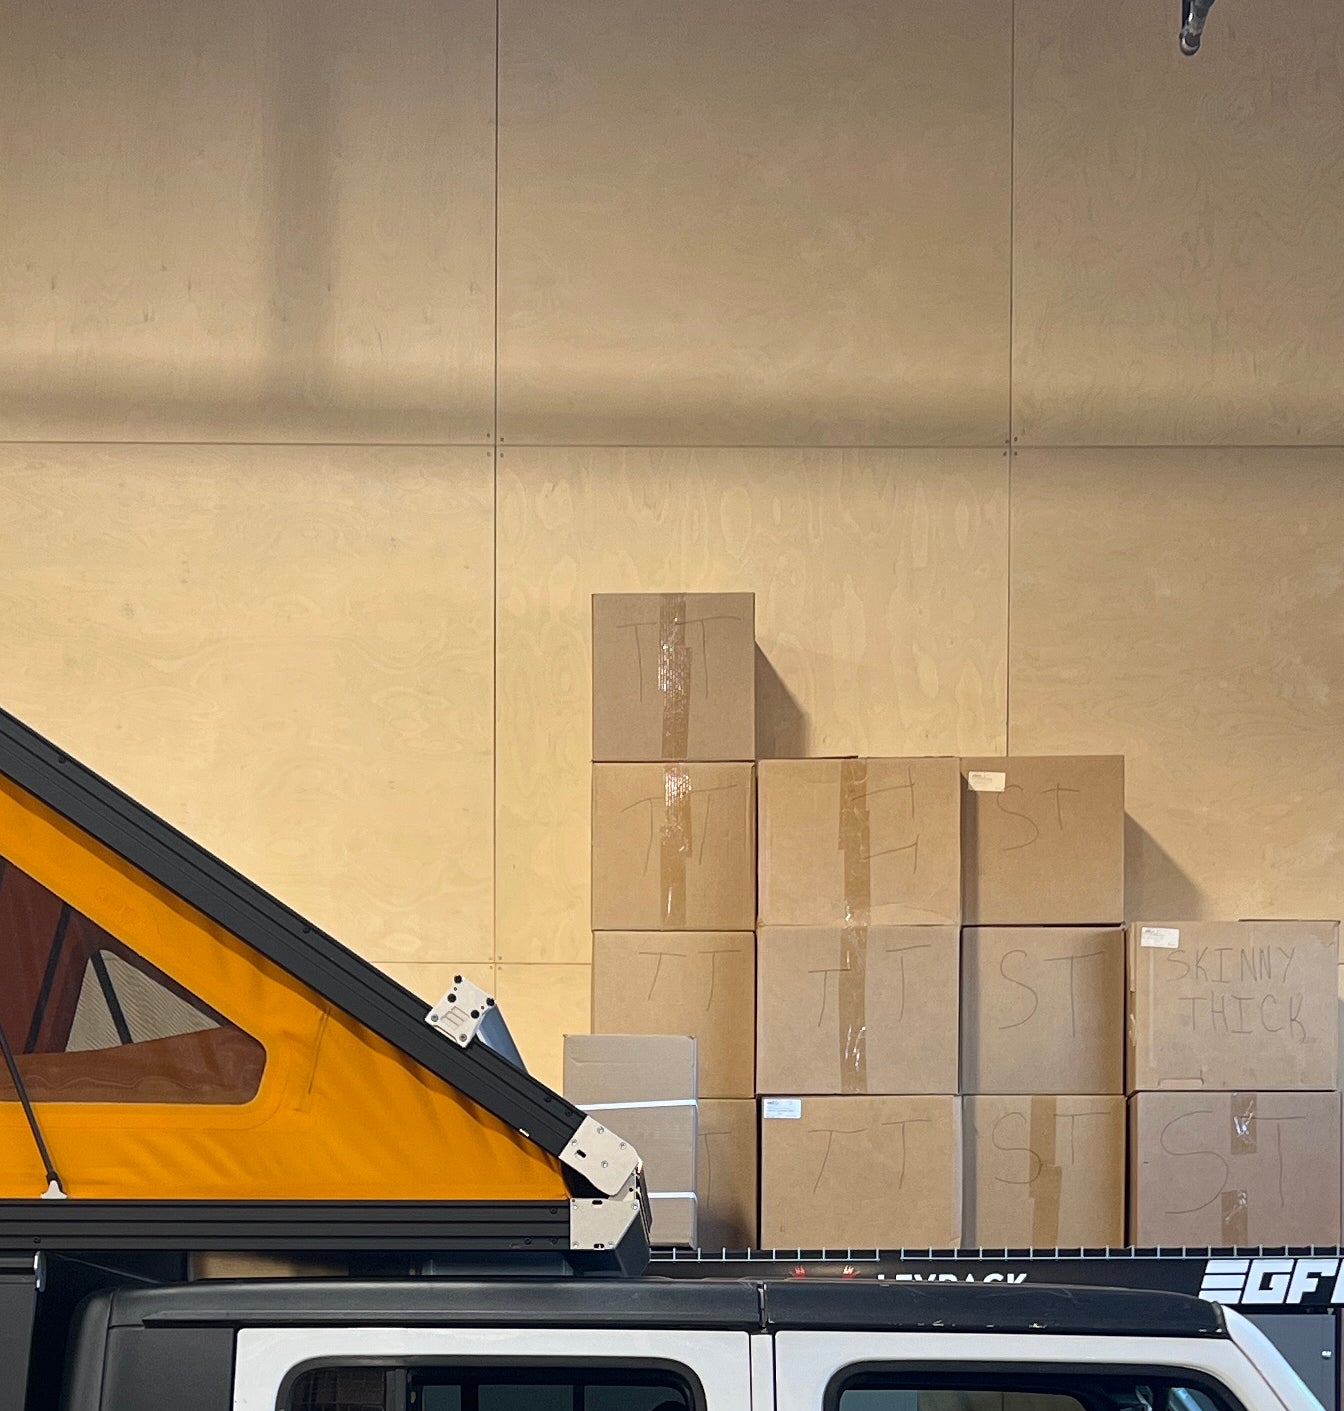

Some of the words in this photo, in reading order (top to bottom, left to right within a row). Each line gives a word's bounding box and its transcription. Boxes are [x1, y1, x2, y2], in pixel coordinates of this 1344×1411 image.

[998, 949, 1106, 1038] ST
[1165, 945, 1296, 985] SKINNY
[1177, 991, 1307, 1045] THICK
[991, 1111, 1111, 1185] ST
